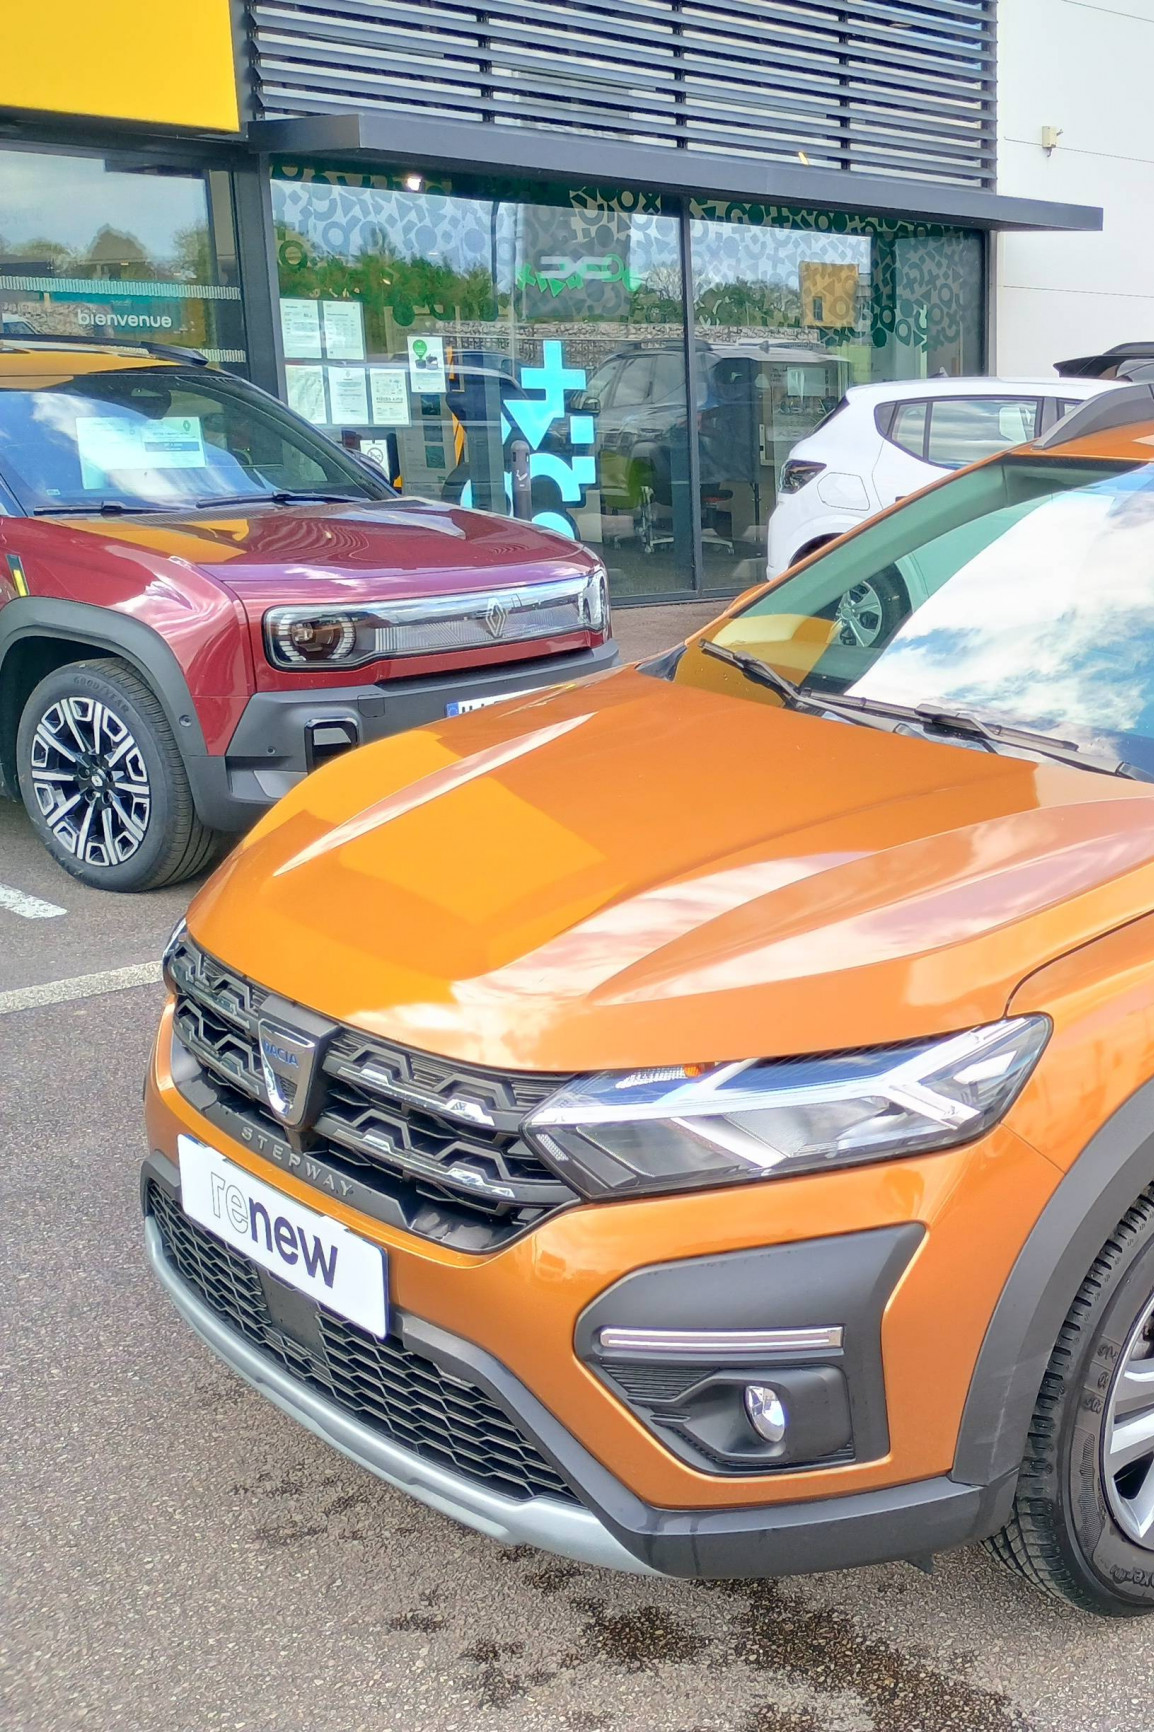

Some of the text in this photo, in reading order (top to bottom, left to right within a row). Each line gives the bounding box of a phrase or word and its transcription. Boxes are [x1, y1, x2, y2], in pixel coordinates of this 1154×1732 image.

[77, 309, 172, 328] bienvenue
[262, 1038, 300, 1069] DACIA
[240, 1126, 354, 1197] STEPWAY
[211, 1171, 339, 1289] renew
